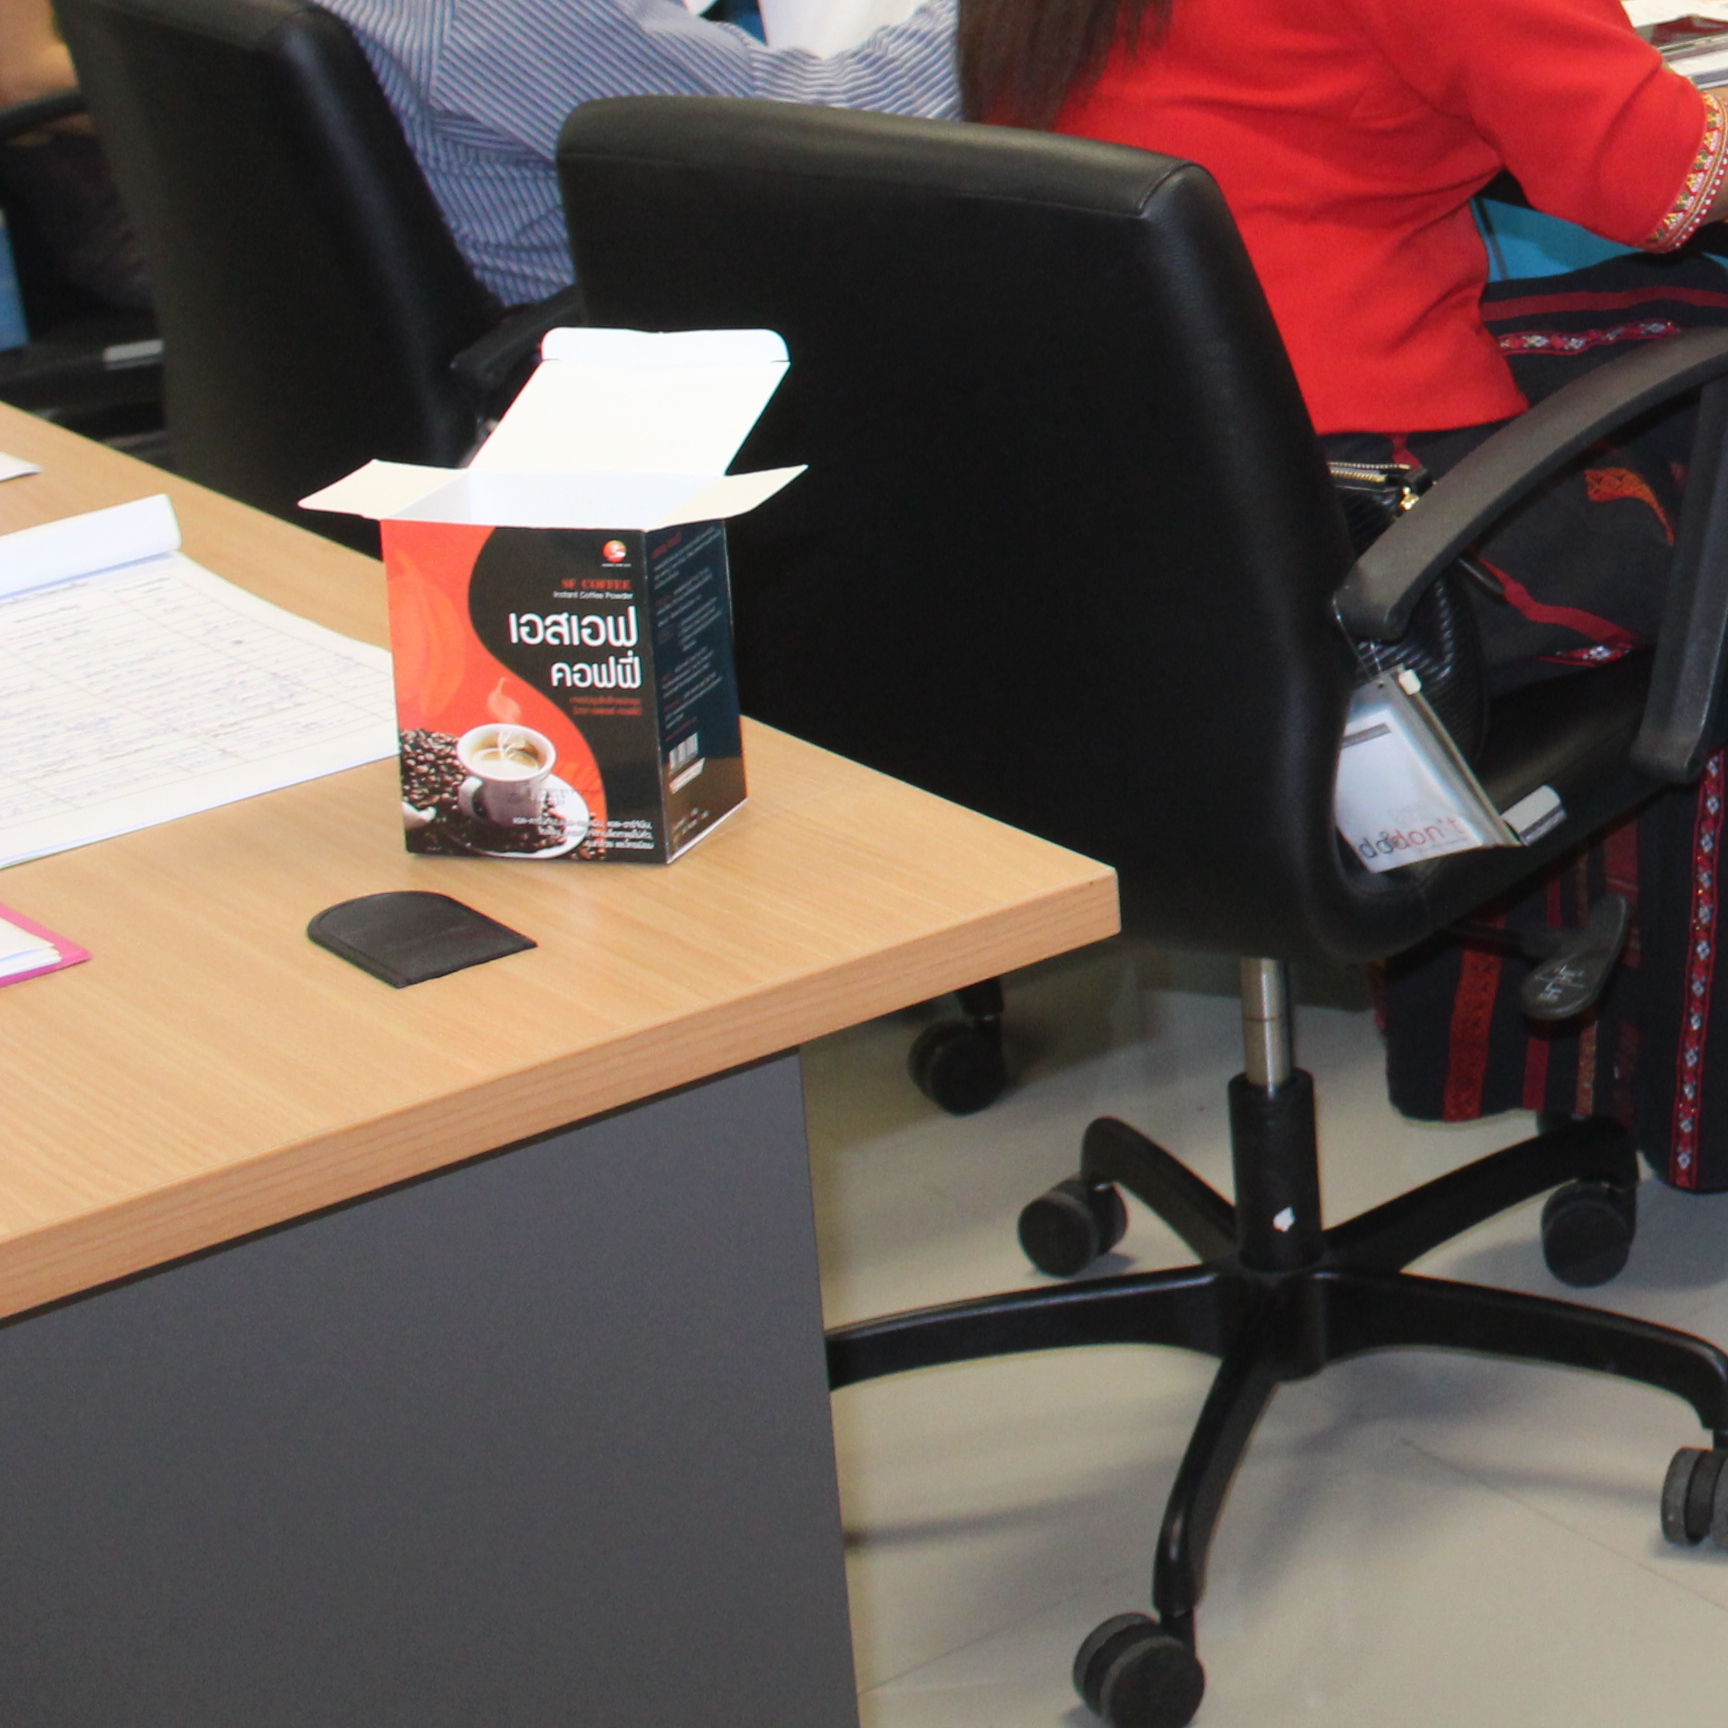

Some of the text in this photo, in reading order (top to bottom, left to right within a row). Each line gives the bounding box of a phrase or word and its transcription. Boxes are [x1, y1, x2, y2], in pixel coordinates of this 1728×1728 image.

[552, 590, 634, 601] Instant Coffee Powder
[580, 579, 632, 591] COFFEE
[510, 606, 638, 647] เอสเอฟ
[551, 650, 642, 688] คอฟฟี่
